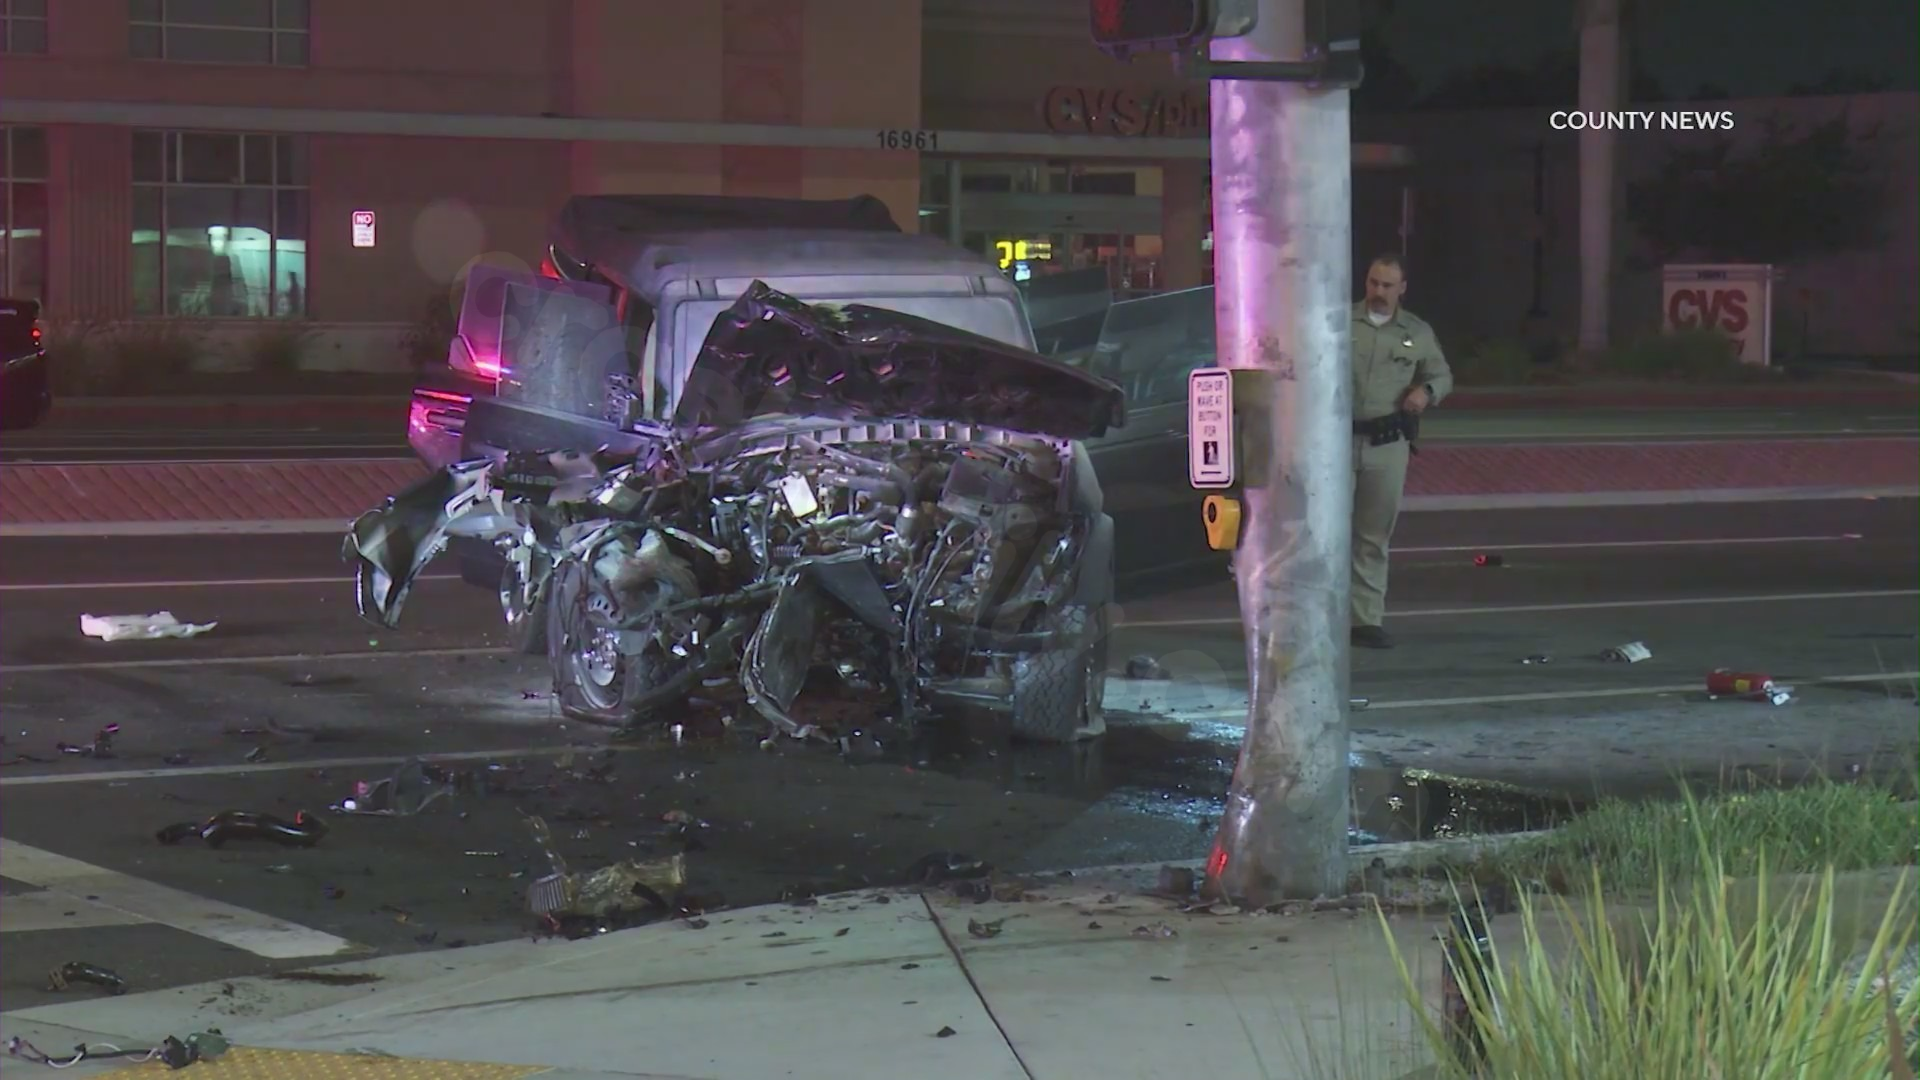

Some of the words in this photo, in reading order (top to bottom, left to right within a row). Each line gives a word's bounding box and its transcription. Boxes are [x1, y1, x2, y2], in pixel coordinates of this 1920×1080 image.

[876, 130, 938, 150] 16961
[356, 214, 372, 224] NO
[1669, 289, 1749, 333] CVS
